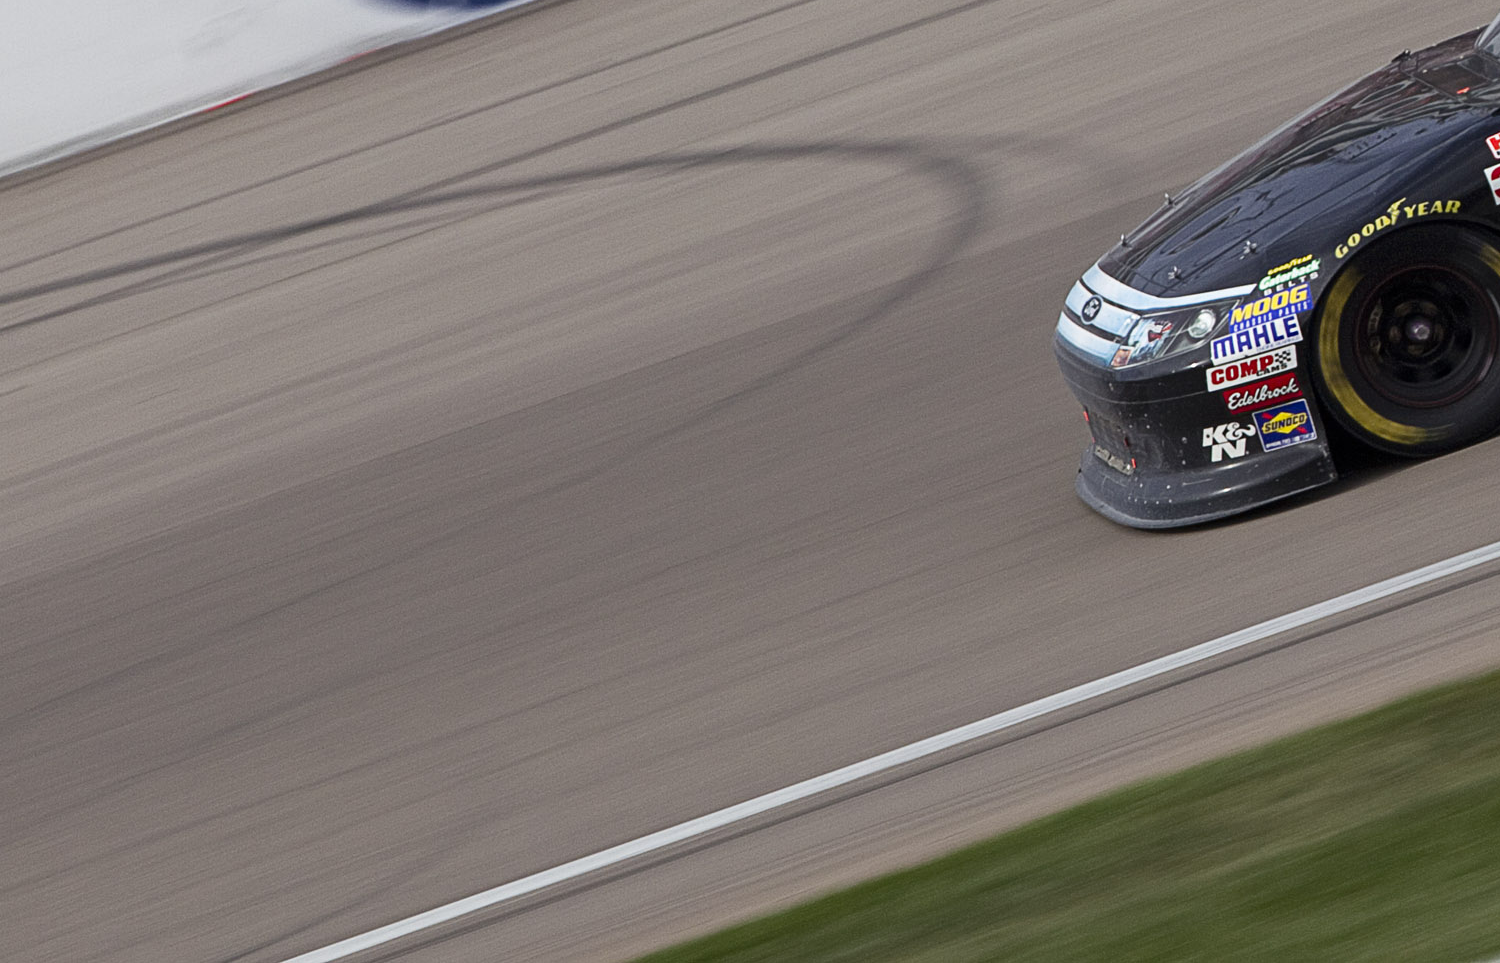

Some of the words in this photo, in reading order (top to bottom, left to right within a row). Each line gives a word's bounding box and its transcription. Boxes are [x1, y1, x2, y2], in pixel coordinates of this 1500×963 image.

[1335, 197, 1461, 259] GOODYEAR
[1264, 271, 1319, 297] BELTS
[1230, 283, 1309, 325] MOOG
[1233, 312, 1272, 332] CHASSIS
[1278, 301, 1308, 317] PARTS
[1213, 316, 1299, 359] MAHLE
[1211, 355, 1274, 385] COMP
[1256, 363, 1288, 376] CAMS
[1228, 377, 1299, 410] Edelbrock
[1265, 413, 1306, 433] SUNOCO
